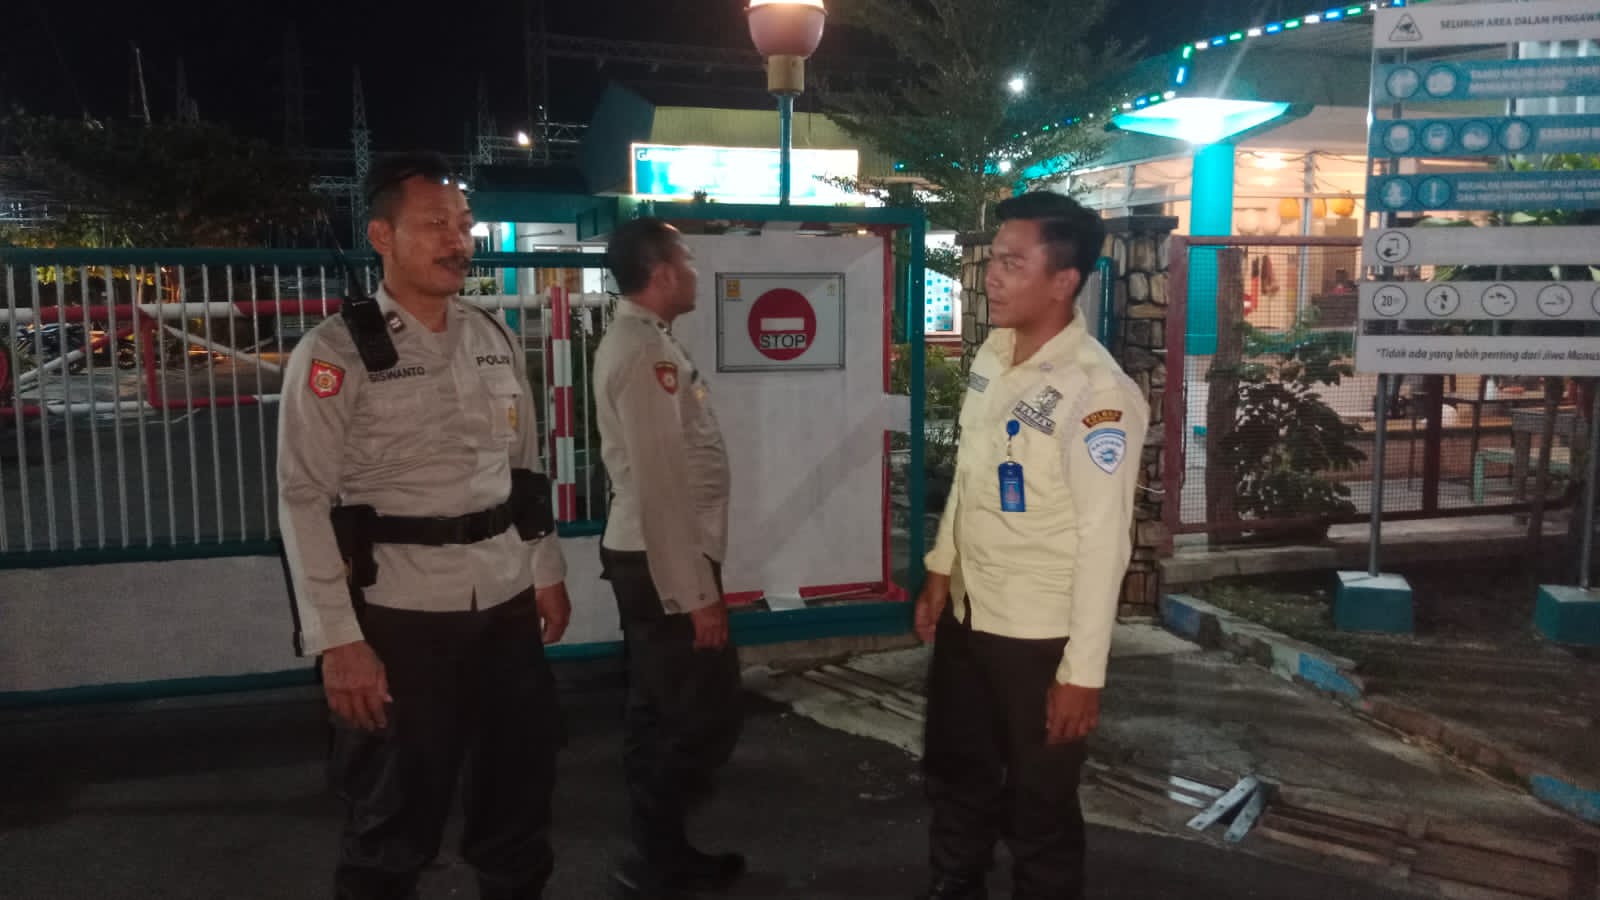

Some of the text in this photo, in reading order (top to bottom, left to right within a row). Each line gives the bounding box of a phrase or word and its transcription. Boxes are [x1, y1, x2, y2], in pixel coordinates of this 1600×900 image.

[1440, 13, 1600, 29] SELURUH AREA DALAM PENGAW
[760, 334, 806, 349] STOP
[1408, 347, 1428, 359] ada
[1428, 350, 1454, 362] yang
[1455, 347, 1479, 359] lebih
[1480, 348, 1519, 363] penting
[1520, 348, 1542, 360] dari
[367, 366, 426, 382] SISWANTO
